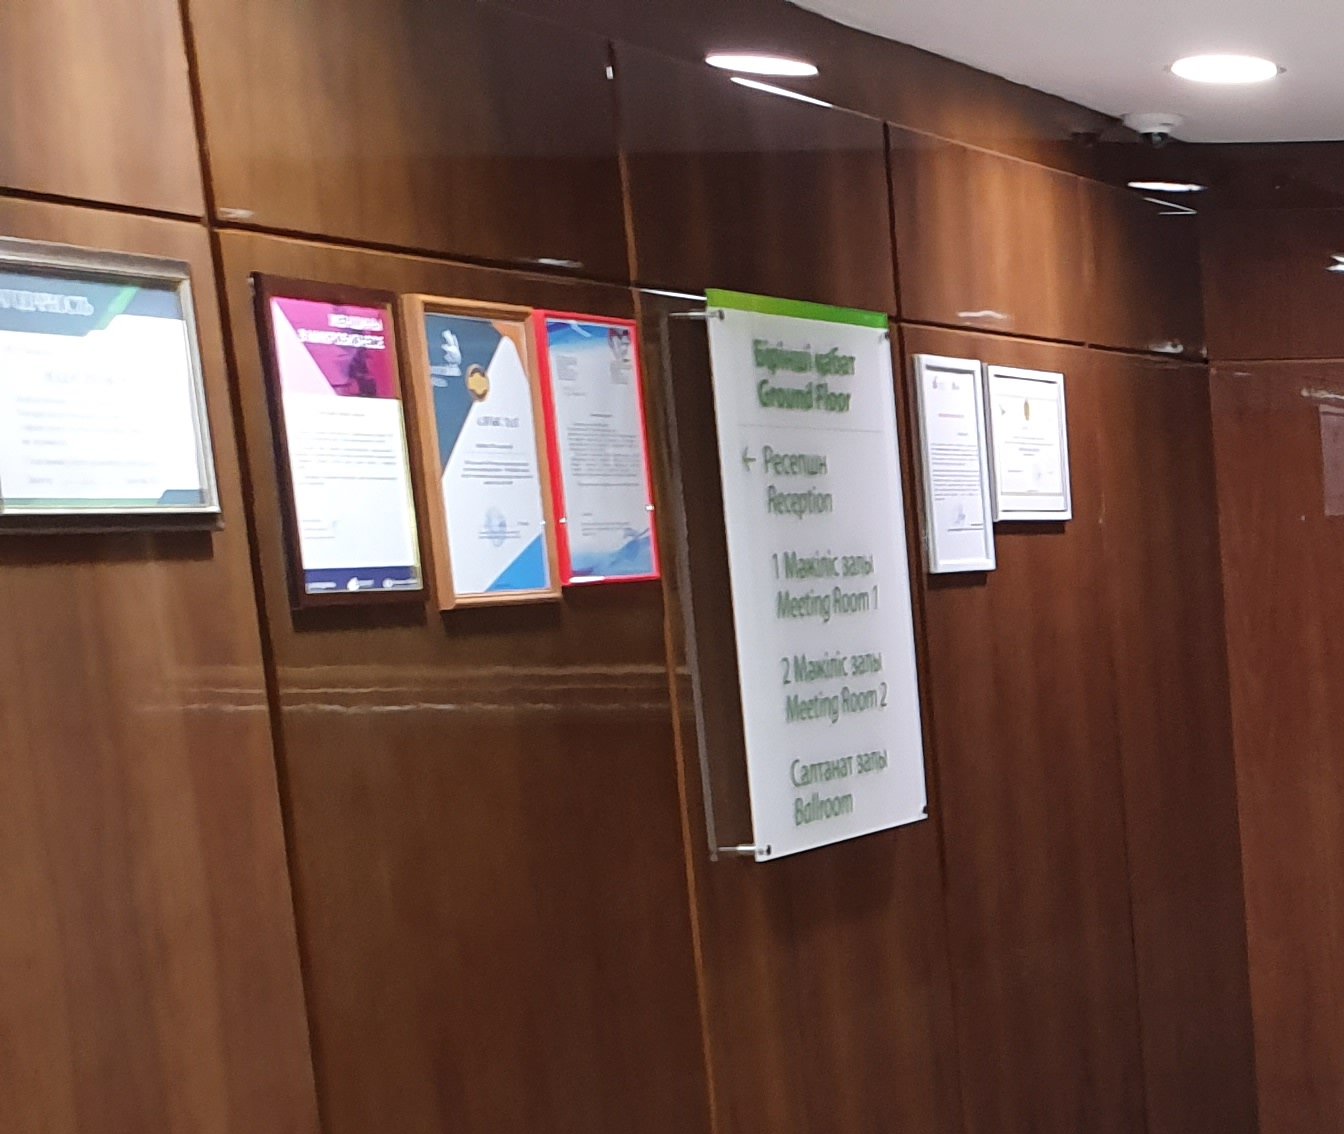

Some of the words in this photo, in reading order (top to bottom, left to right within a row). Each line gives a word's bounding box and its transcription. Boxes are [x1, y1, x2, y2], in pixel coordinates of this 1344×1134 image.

[757, 379, 814, 411] Ground
[815, 382, 851, 412] Floor
[762, 445, 828, 475] Ресепшн
[767, 484, 833, 520] Reception
[772, 553, 780, 579] 1
[841, 553, 875, 578] залы
[777, 588, 832, 623] Meeting
[832, 586, 870, 614] Room
[872, 584, 879, 610] 1
[780, 656, 792, 685] 2
[851, 652, 883, 677] залы
[785, 690, 840, 724] Meeting
[841, 686, 878, 713] Room
[879, 682, 888, 708] 2
[790, 758, 853, 788] Салтанат
[856, 749, 888, 774] залы
[794, 792, 853, 826] Ballroom
